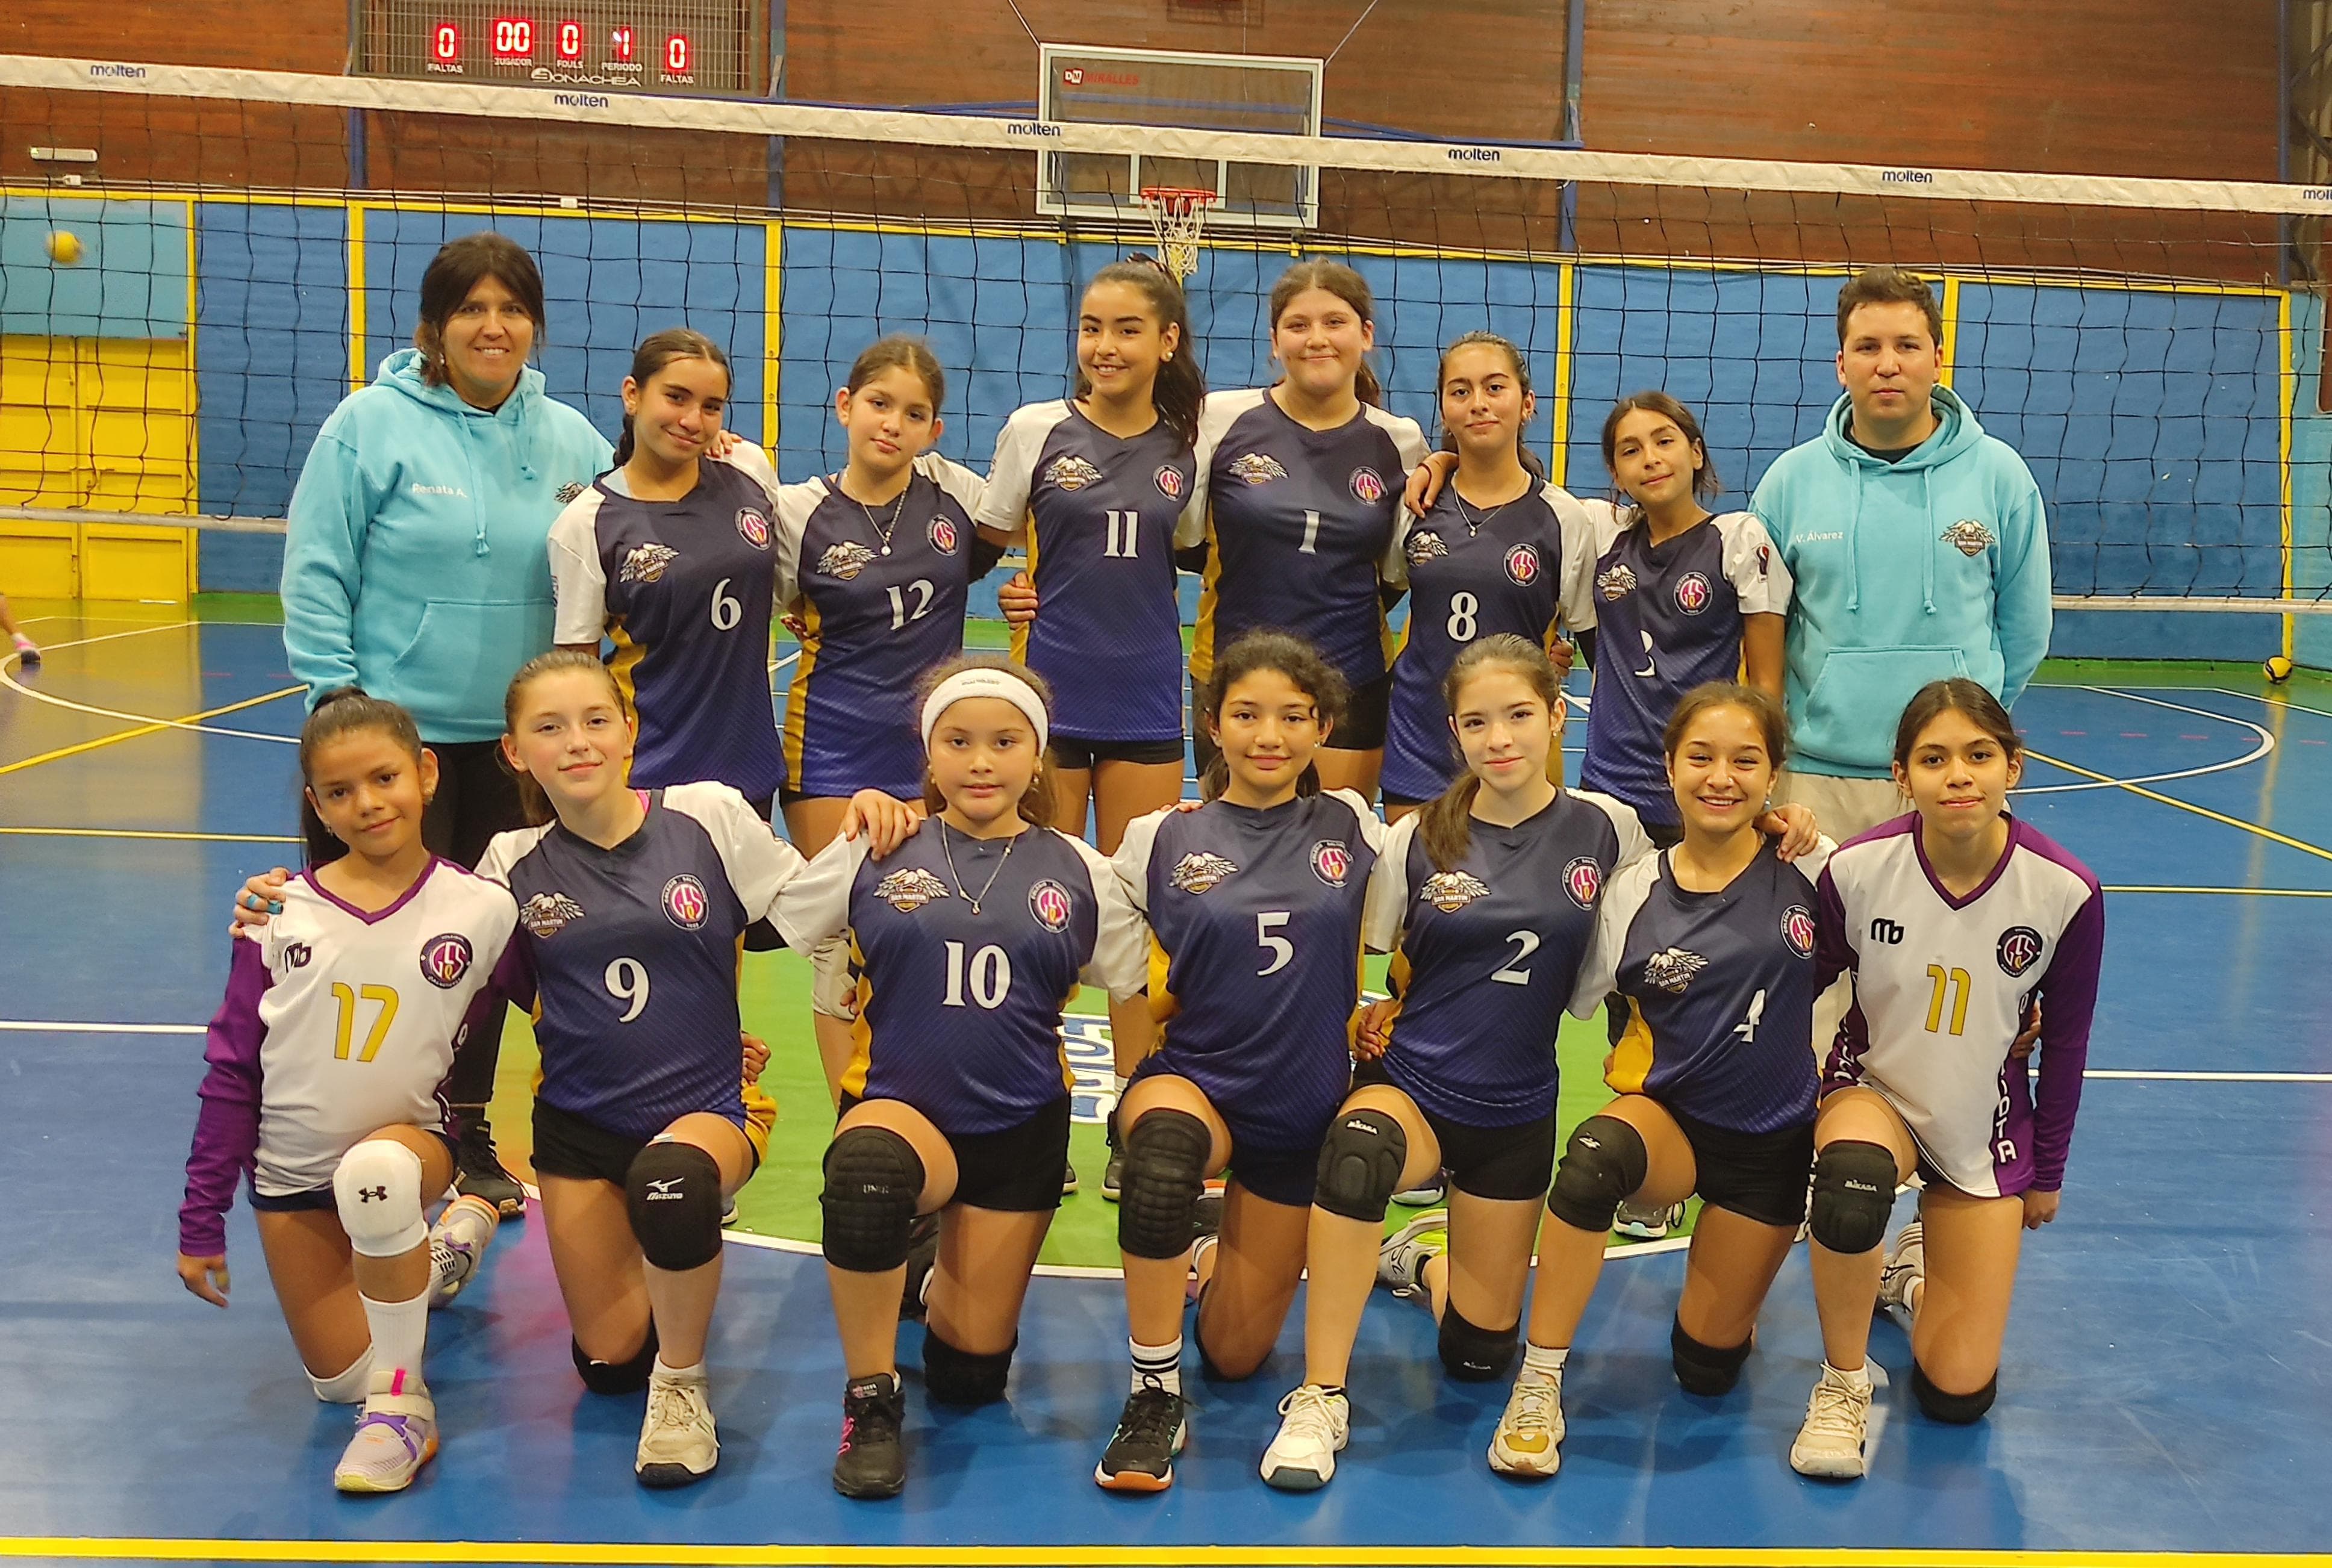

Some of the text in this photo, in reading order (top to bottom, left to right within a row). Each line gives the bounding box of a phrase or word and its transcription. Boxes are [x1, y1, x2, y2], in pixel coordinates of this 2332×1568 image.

[438, 27, 455, 58] 0
[496, 22, 530, 52] 00
[561, 25, 578, 54] 0
[427, 63, 463, 73] FALTAS
[493, 57, 532, 66] JUGADOR
[557, 60, 584, 69] FOULS
[601, 62, 643, 72] PERIODO
[669, 38, 685, 69] 0
[90, 64, 146, 78] molten
[660, 74, 694, 84] FALTAS
[554, 94, 609, 108] molten
[1007, 123, 1061, 136] molten
[1448, 148, 1500, 161] molten
[1882, 170, 1933, 183] molten
[1104, 510, 1139, 558] 11
[1298, 509, 1320, 555] 1
[711, 578, 743, 630] 6
[886, 579, 935, 631] 12
[1447, 591, 1479, 642] 8
[1257, 912, 1294, 977] 5
[1491, 930, 1541, 986] 2
[605, 957, 650, 1023] 9
[942, 941, 1012, 1010] 10
[1924, 963, 1971, 1036] 11
[331, 982, 399, 1063] 17
